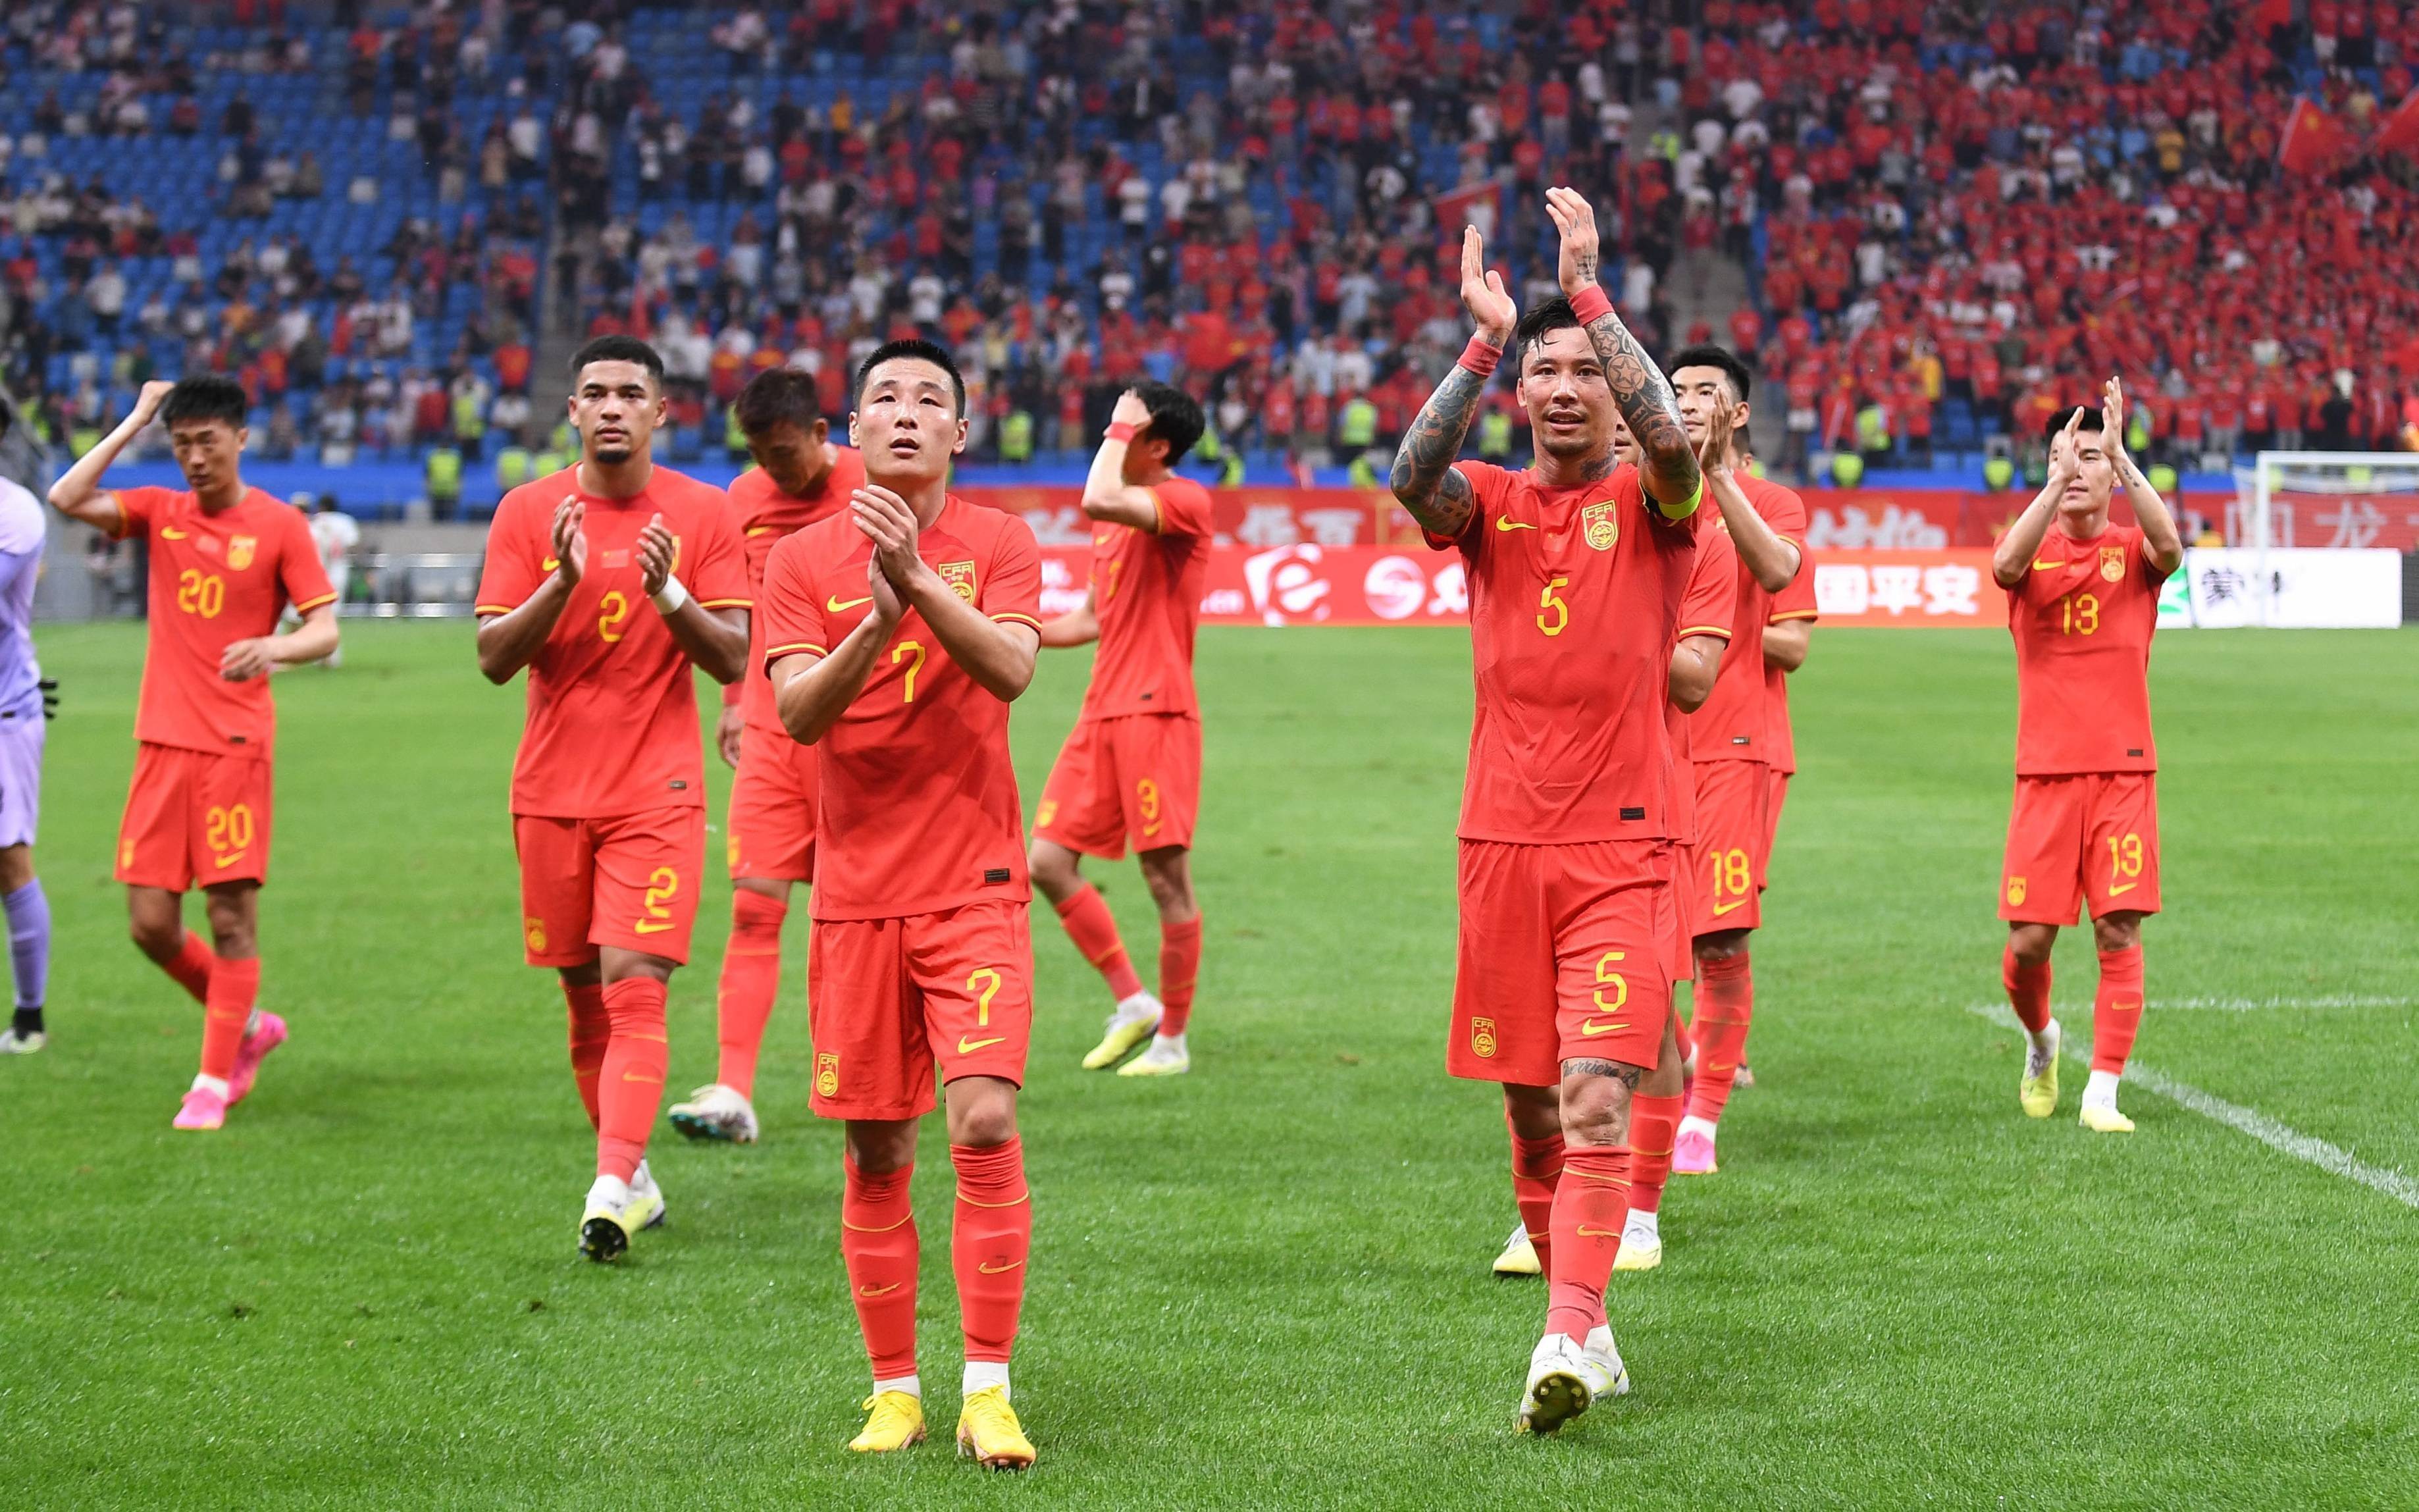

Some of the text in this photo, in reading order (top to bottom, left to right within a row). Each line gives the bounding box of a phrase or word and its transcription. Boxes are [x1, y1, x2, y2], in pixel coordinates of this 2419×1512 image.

[1586, 504, 1613, 519] CFA
[177, 568, 225, 619] 20
[941, 565, 972, 577] CFA
[598, 590, 628, 642] 2
[1536, 577, 1569, 637] 5
[2060, 592, 2100, 636] 13
[891, 640, 926, 703] 7
[206, 803, 255, 851] 20
[1710, 847, 1751, 897] 18
[2106, 831, 2143, 879] 13
[644, 866, 679, 919] 2
[966, 968, 1002, 1027] 7
[1593, 951, 1628, 1013] 5
[1474, 1020, 1494, 1030] CFA
